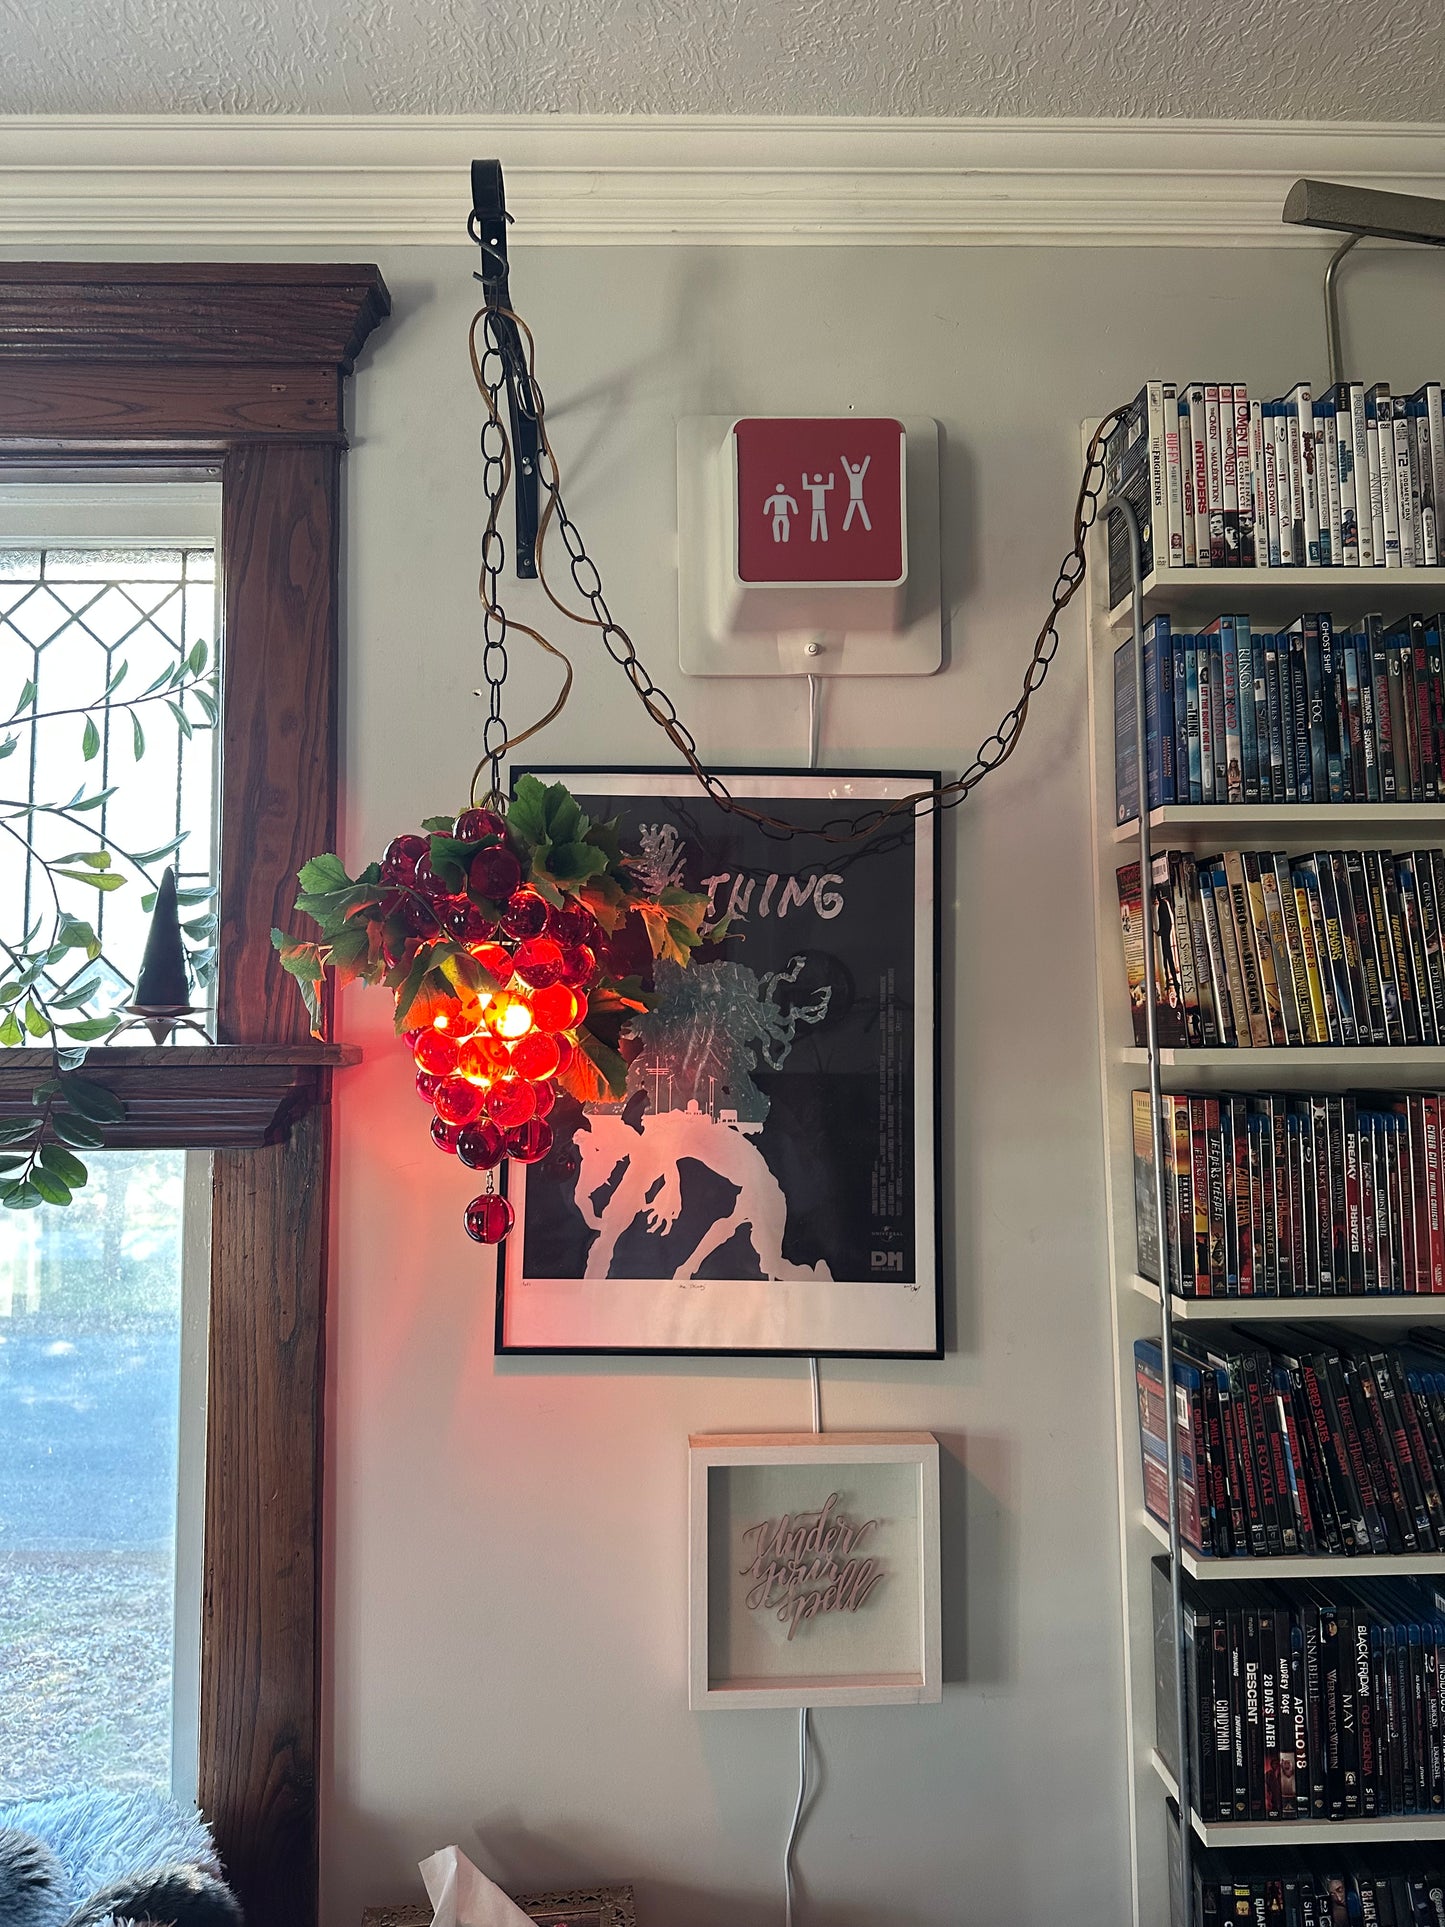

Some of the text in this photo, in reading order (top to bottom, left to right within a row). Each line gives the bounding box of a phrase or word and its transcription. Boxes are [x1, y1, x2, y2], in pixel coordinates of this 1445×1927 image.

[1167, 433, 1178, 464] BUFFY
[1209, 415, 1217, 439] OMEN
[1235, 406, 1248, 458] OMEN III
[1355, 394, 1366, 459] POLTERGEIST
[1225, 447, 1235, 477] OMEN
[1398, 450, 1408, 467] T2
[1435, 445, 1442, 457] LA
[1152, 450, 1162, 506] FRIGHTENERS
[1211, 452, 1220, 502] MALÉDICTION
[1266, 443, 1276, 516] 47 METERS DOWN
[1279, 473, 1286, 482] IT
[1382, 467, 1390, 486] LIES
[1238, 648, 1252, 690] RINGS
[1321, 622, 1331, 673] GHOST SHIP
[1415, 649, 1426, 671] CRAWL
[1214, 682, 1224, 743] HANNIBAL
[1224, 652, 1237, 729] CLUB DREAD
[1282, 664, 1290, 722] UNDERWATER
[1295, 685, 1303, 703] LAST
[1311, 698, 1322, 722] FOG
[1363, 686, 1372, 724] TREMORS
[1188, 709, 1198, 737] THING
[1202, 731, 1210, 743] ONE
[1296, 703, 1306, 735] WITCH
[1298, 737, 1308, 775] HUNTER
[700, 872, 844, 920] THING
[1281, 877, 1297, 933] THE CRAZIES
[1422, 882, 1434, 921] CURSED
[1177, 915, 1195, 993] HILLS EYES
[1192, 920, 1209, 983] MONSTER SQUAD
[1232, 884, 1260, 1014] HOBO SHOTGUN
[1302, 926, 1313, 961] SUPER
[1326, 918, 1342, 960] DEMONS
[1391, 914, 1411, 1001] TUCKER DALE EVIL
[1365, 958, 1379, 995] HALLOWEEN
[1414, 956, 1426, 997] EDITOR
[1194, 1146, 1207, 1216] JEEPERS 2
[1318, 1164, 1327, 1190] NEXT
[1347, 1133, 1357, 1181] FREAKY
[1427, 1124, 1439, 1231] CYBER CITY THE FINAL COLLECTION
[1236, 1167, 1250, 1226] CABIN FEVER
[1252, 1175, 1261, 1230] ZOMBIELAND
[1292, 1162, 1300, 1209] SINISTER
[1266, 1211, 1274, 1254] UNRATED
[1350, 1205, 1360, 1253] BIZARRE
[871, 1251, 903, 1271] DM
[1236, 1402, 1247, 1437] GRAVE
[1304, 1366, 1329, 1443] ALTERED STATES
[1194, 1438, 1204, 1455] PLAY
[1209, 1418, 1219, 1446] SMILE
[1248, 1383, 1273, 1506] BATTLE ROYALE
[1331, 1432, 1349, 1477] RESORT
[1336, 1396, 1376, 1508] HOUSE HAUNTED HILL
[1393, 1428, 1412, 1464] RINGU
[1412, 1427, 1433, 1482] TENSION
[1213, 1465, 1225, 1510] SOURIRE
[1241, 1438, 1256, 1508] ENCOUNTERS
[1276, 1470, 1286, 1494] DEAD
[1371, 1459, 1384, 1487] DEATH
[742, 1492, 878, 1560] Under
[739, 1554, 840, 1610] your
[765, 1559, 885, 1641] spell
[1306, 1624, 1320, 1703] ANNABELLE
[1357, 1625, 1370, 1697] BLACK FRIDAY!
[1245, 1662, 1258, 1725] DESCENT
[1279, 1658, 1290, 1715] AUDREY ROSE
[1201, 1696, 1211, 1727] FREDDY
[1216, 1699, 1231, 1751] CANDYMAN
[1263, 1674, 1276, 1748] 28 DAYS LATER
[1293, 1696, 1307, 1769] APOLLO 18
[1326, 1669, 1338, 1769] WEREWOLVES WITHIN
[1342, 1694, 1354, 1734] MAY
[1429, 1698, 1438, 1728] EXORCIST
[1362, 1704, 1372, 1776] VENDREDI FOU
[1361, 1890, 1377, 1921] BLACK
